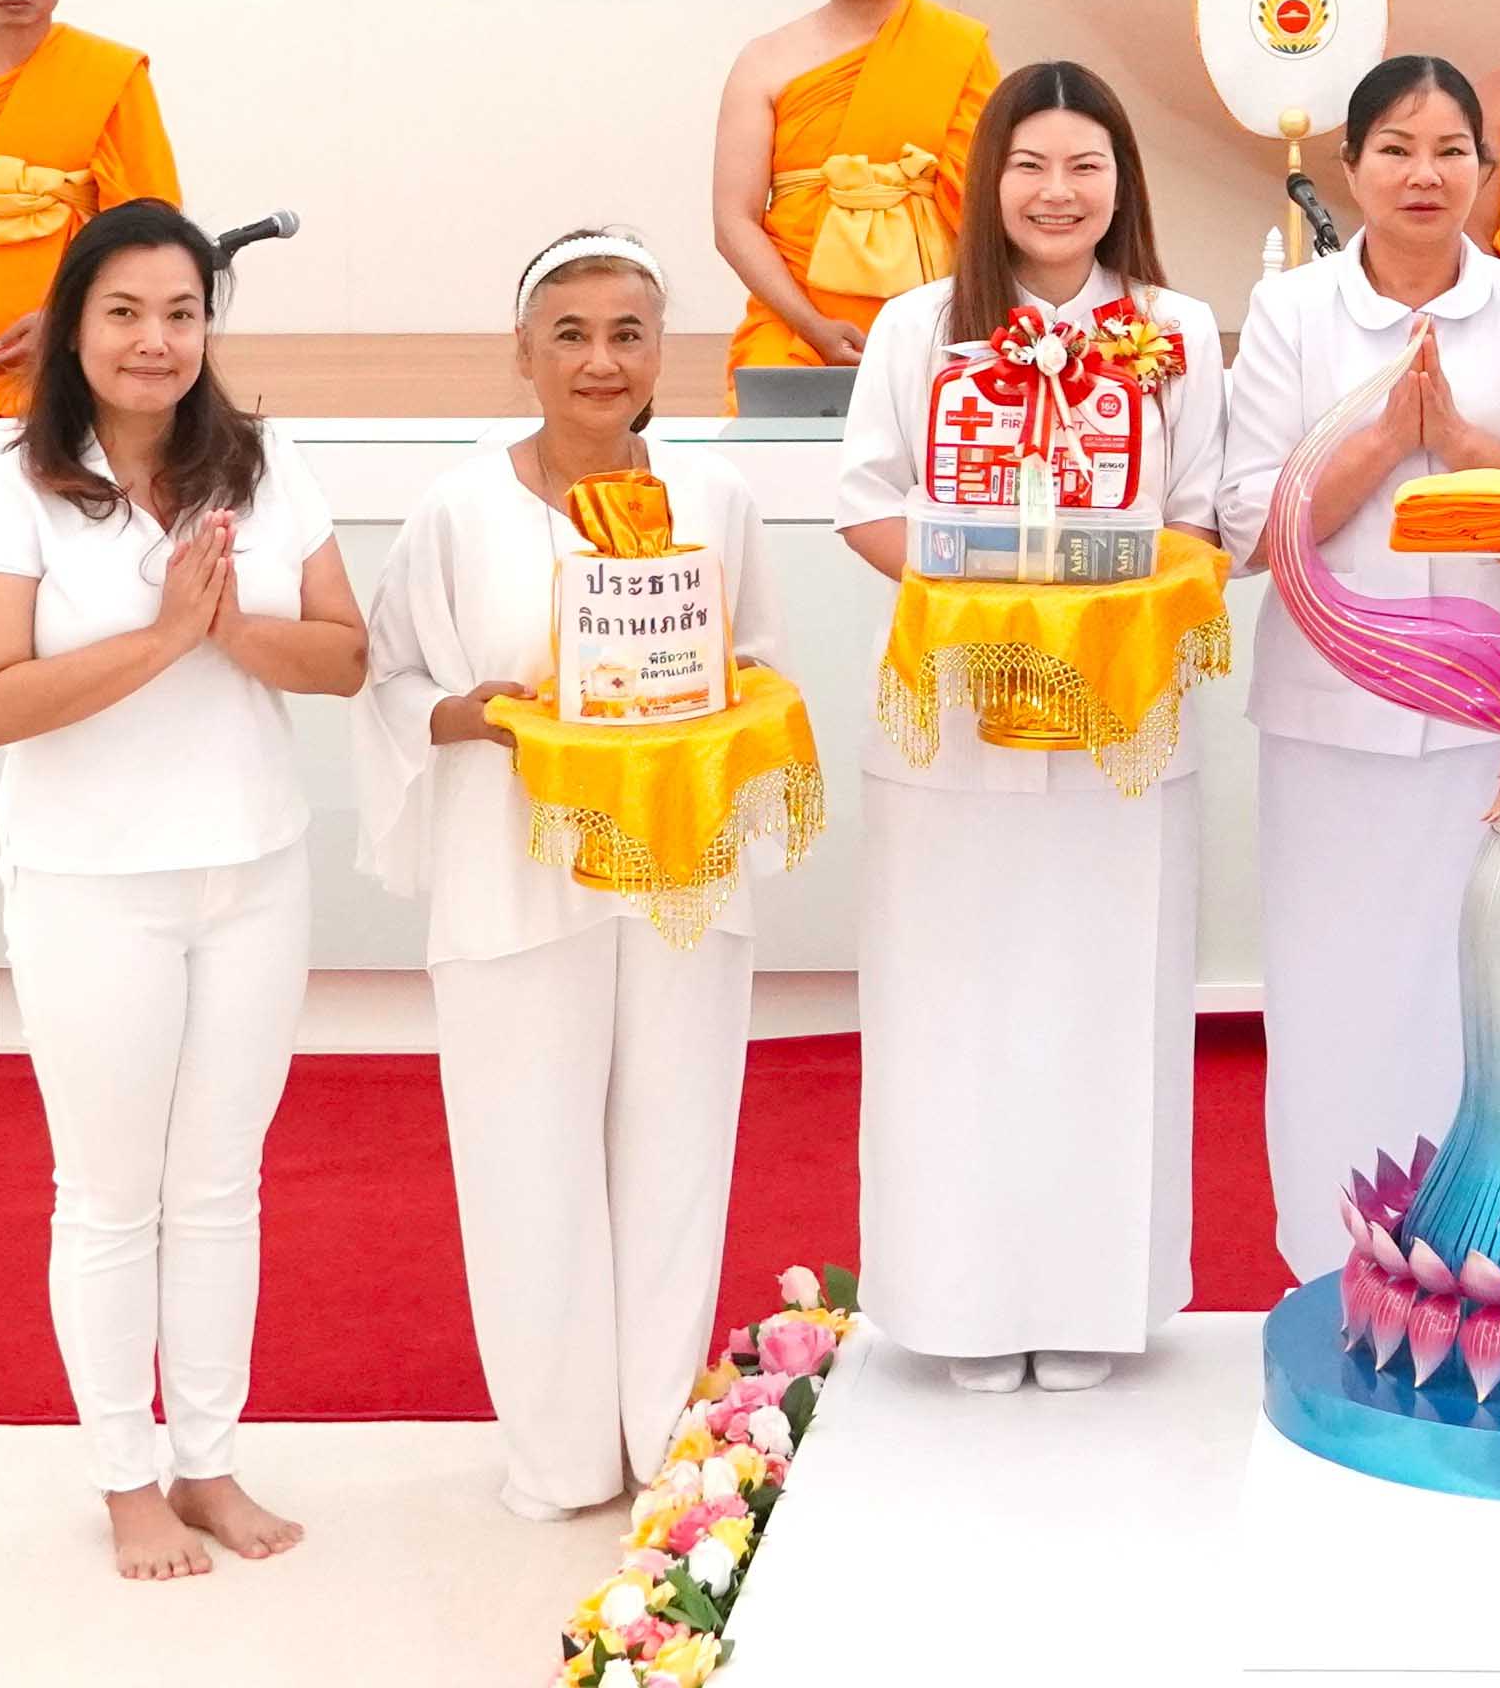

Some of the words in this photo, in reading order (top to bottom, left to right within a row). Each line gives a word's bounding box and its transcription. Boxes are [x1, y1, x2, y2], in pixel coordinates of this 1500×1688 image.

[1069, 537, 1082, 576] Advil
[1116, 537, 1130, 575] Advil
[586, 562, 701, 596] ประธาน
[578, 601, 708, 636] คิลานเภสัช
